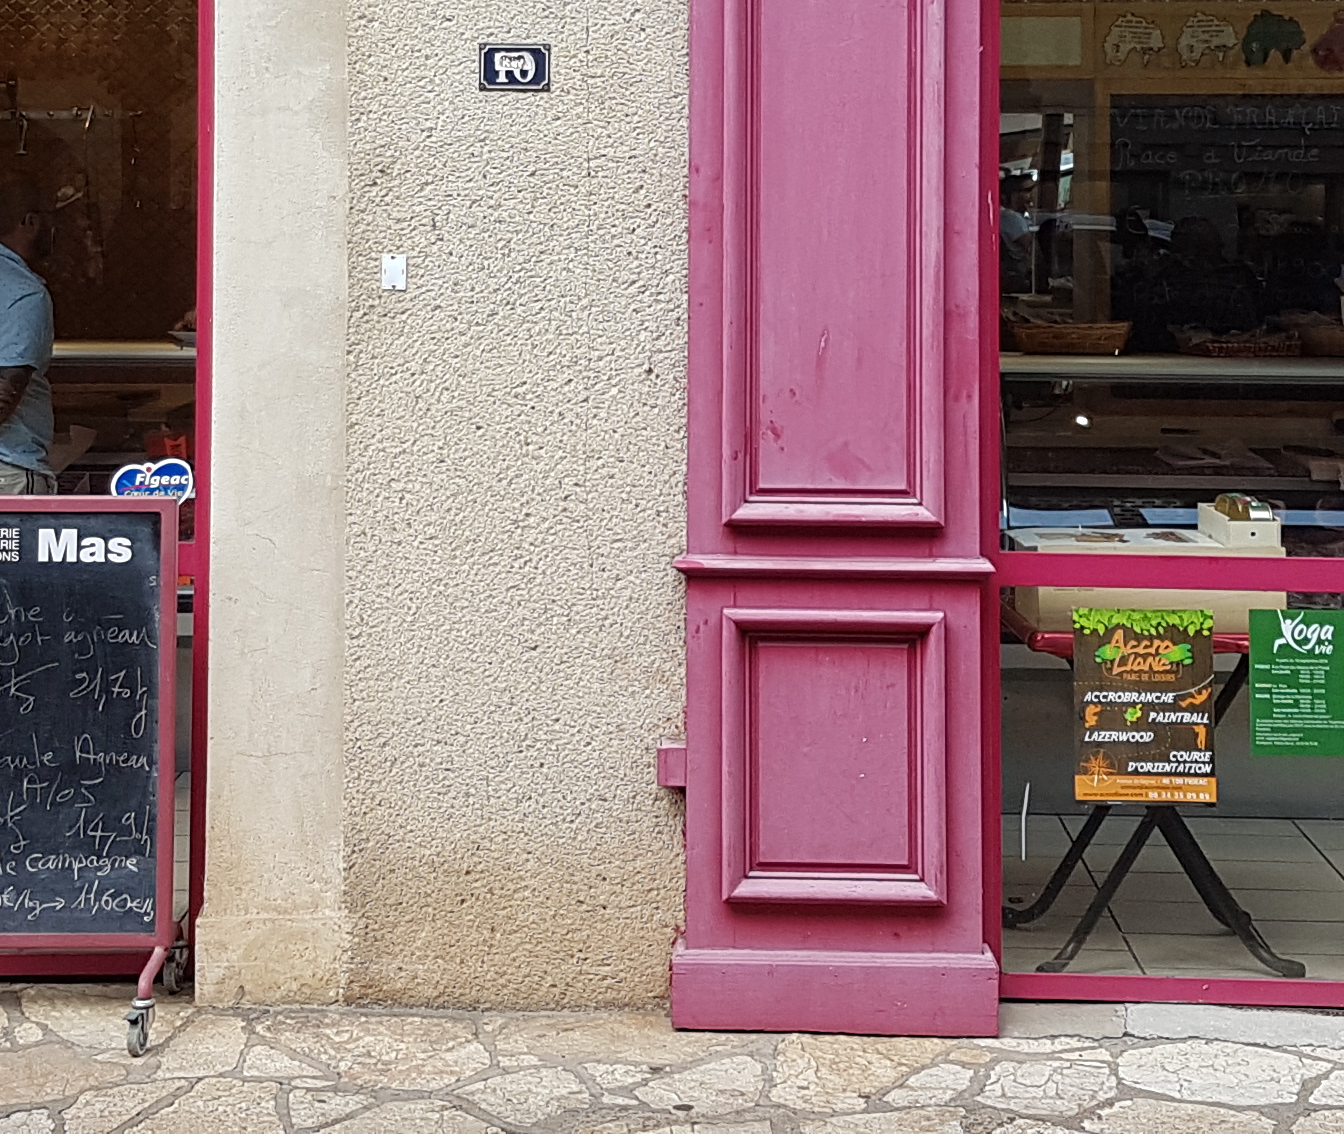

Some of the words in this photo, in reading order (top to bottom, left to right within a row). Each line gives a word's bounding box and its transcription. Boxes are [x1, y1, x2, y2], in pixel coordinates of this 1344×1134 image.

[135, 471, 189, 488] Figeac
[37, 528, 133, 563] Mas
[1314, 641, 1334, 655] vie
[1084, 691, 1176, 704] ACCROBRANCHE
[1148, 712, 1209, 724] PAINTBALL
[1084, 731, 1154, 743] LAZERWOOD
[1169, 751, 1212, 762] COURSE
[1127, 762, 1212, 774] D'ORIENTATION
